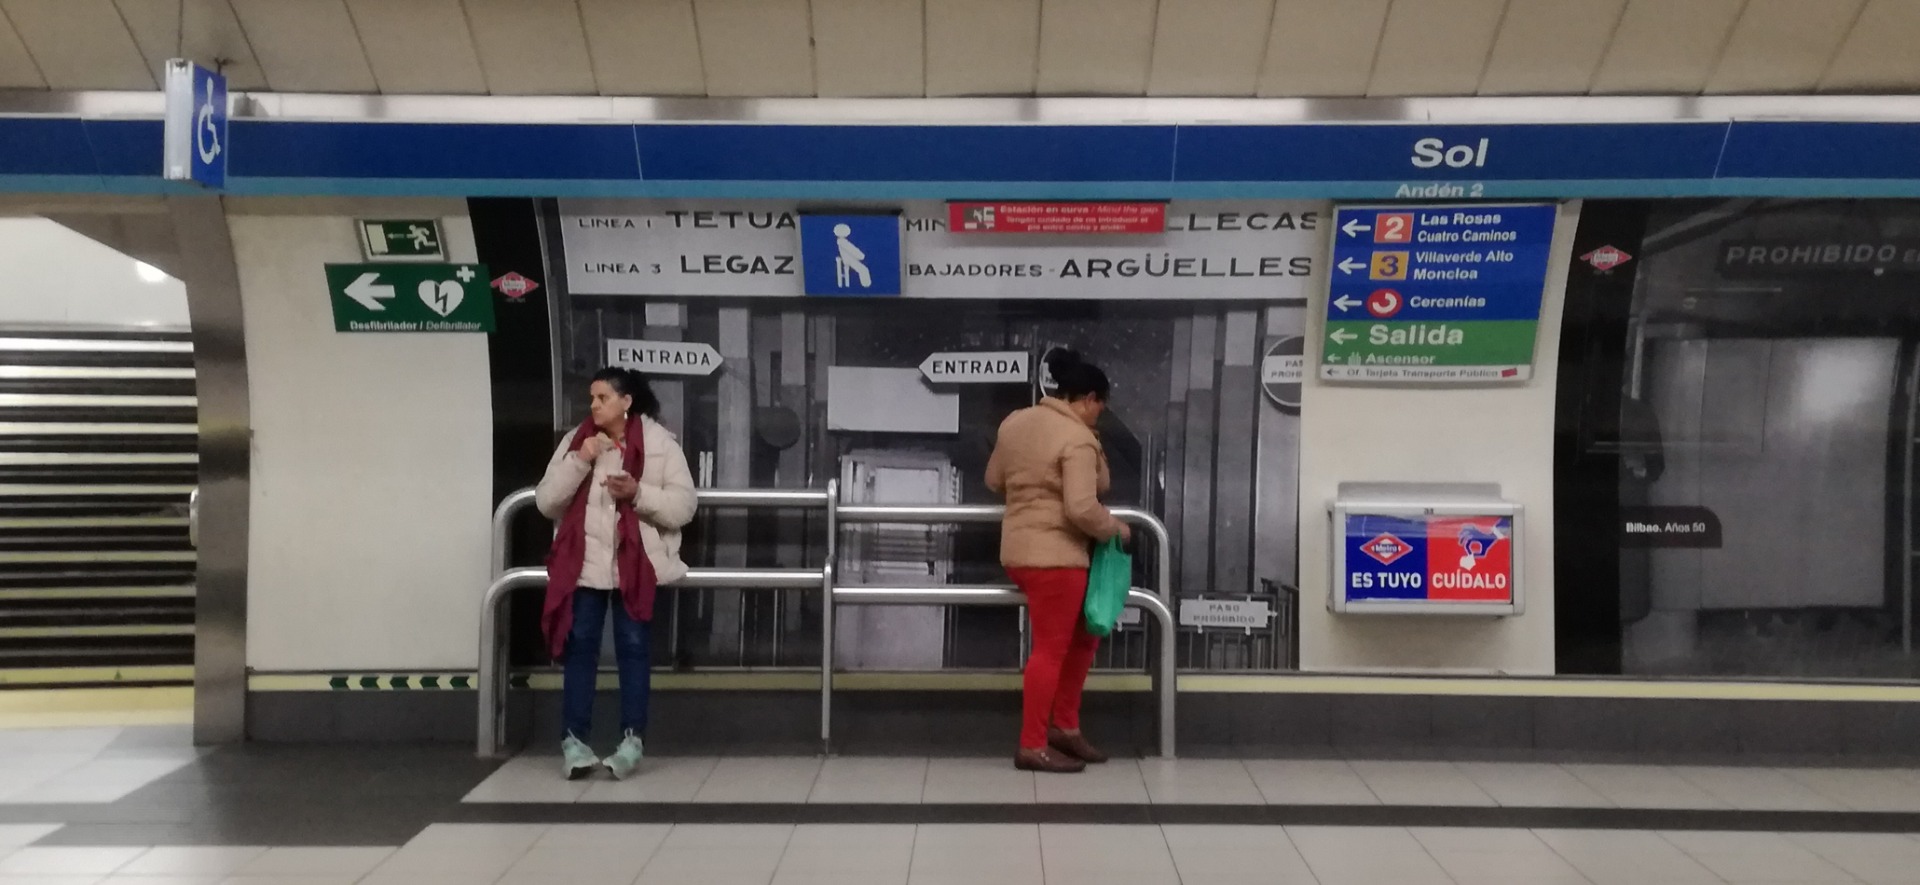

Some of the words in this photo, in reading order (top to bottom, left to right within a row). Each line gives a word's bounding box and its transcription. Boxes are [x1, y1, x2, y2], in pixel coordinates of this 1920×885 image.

[1410, 137, 1489, 168] Sol
[1395, 183, 1464, 198] Andén
[1469, 183, 1484, 198] 2
[578, 218, 638, 229] LINEA
[1420, 214, 1448, 225] Las
[1453, 213, 1502, 225] Rosas
[1384, 217, 1405, 240] 2
[1417, 231, 1459, 242] Cuatro
[1462, 230, 1517, 242] Caminos
[1415, 252, 1482, 263] Villaverde
[1485, 252, 1514, 263] Alto
[1726, 244, 1896, 265] PROHIBIDO
[584, 263, 640, 275] LINEA
[651, 264, 662, 275] 3
[905, 263, 1042, 277] BAJADORES
[1059, 252, 1312, 278] ARGÜELLES
[1379, 255, 1399, 276] 3
[1413, 268, 1478, 280] Moncloa
[1410, 295, 1486, 307] Cercanías
[350, 320, 417, 330] Desfibrilador
[426, 321, 481, 330] Defibrillator
[1369, 324, 1464, 345] Salida
[617, 347, 711, 366] ENTRADA
[1365, 353, 1436, 365] Ascensor
[932, 360, 1021, 375] ENTRADA
[1626, 522, 1662, 533] Bilbao.
[1664, 522, 1690, 533] Años
[1692, 522, 1706, 533] 50
[1352, 572, 1373, 588] ES
[1377, 572, 1422, 588] TUYO
[1432, 569, 1506, 589] CUÍDALO
